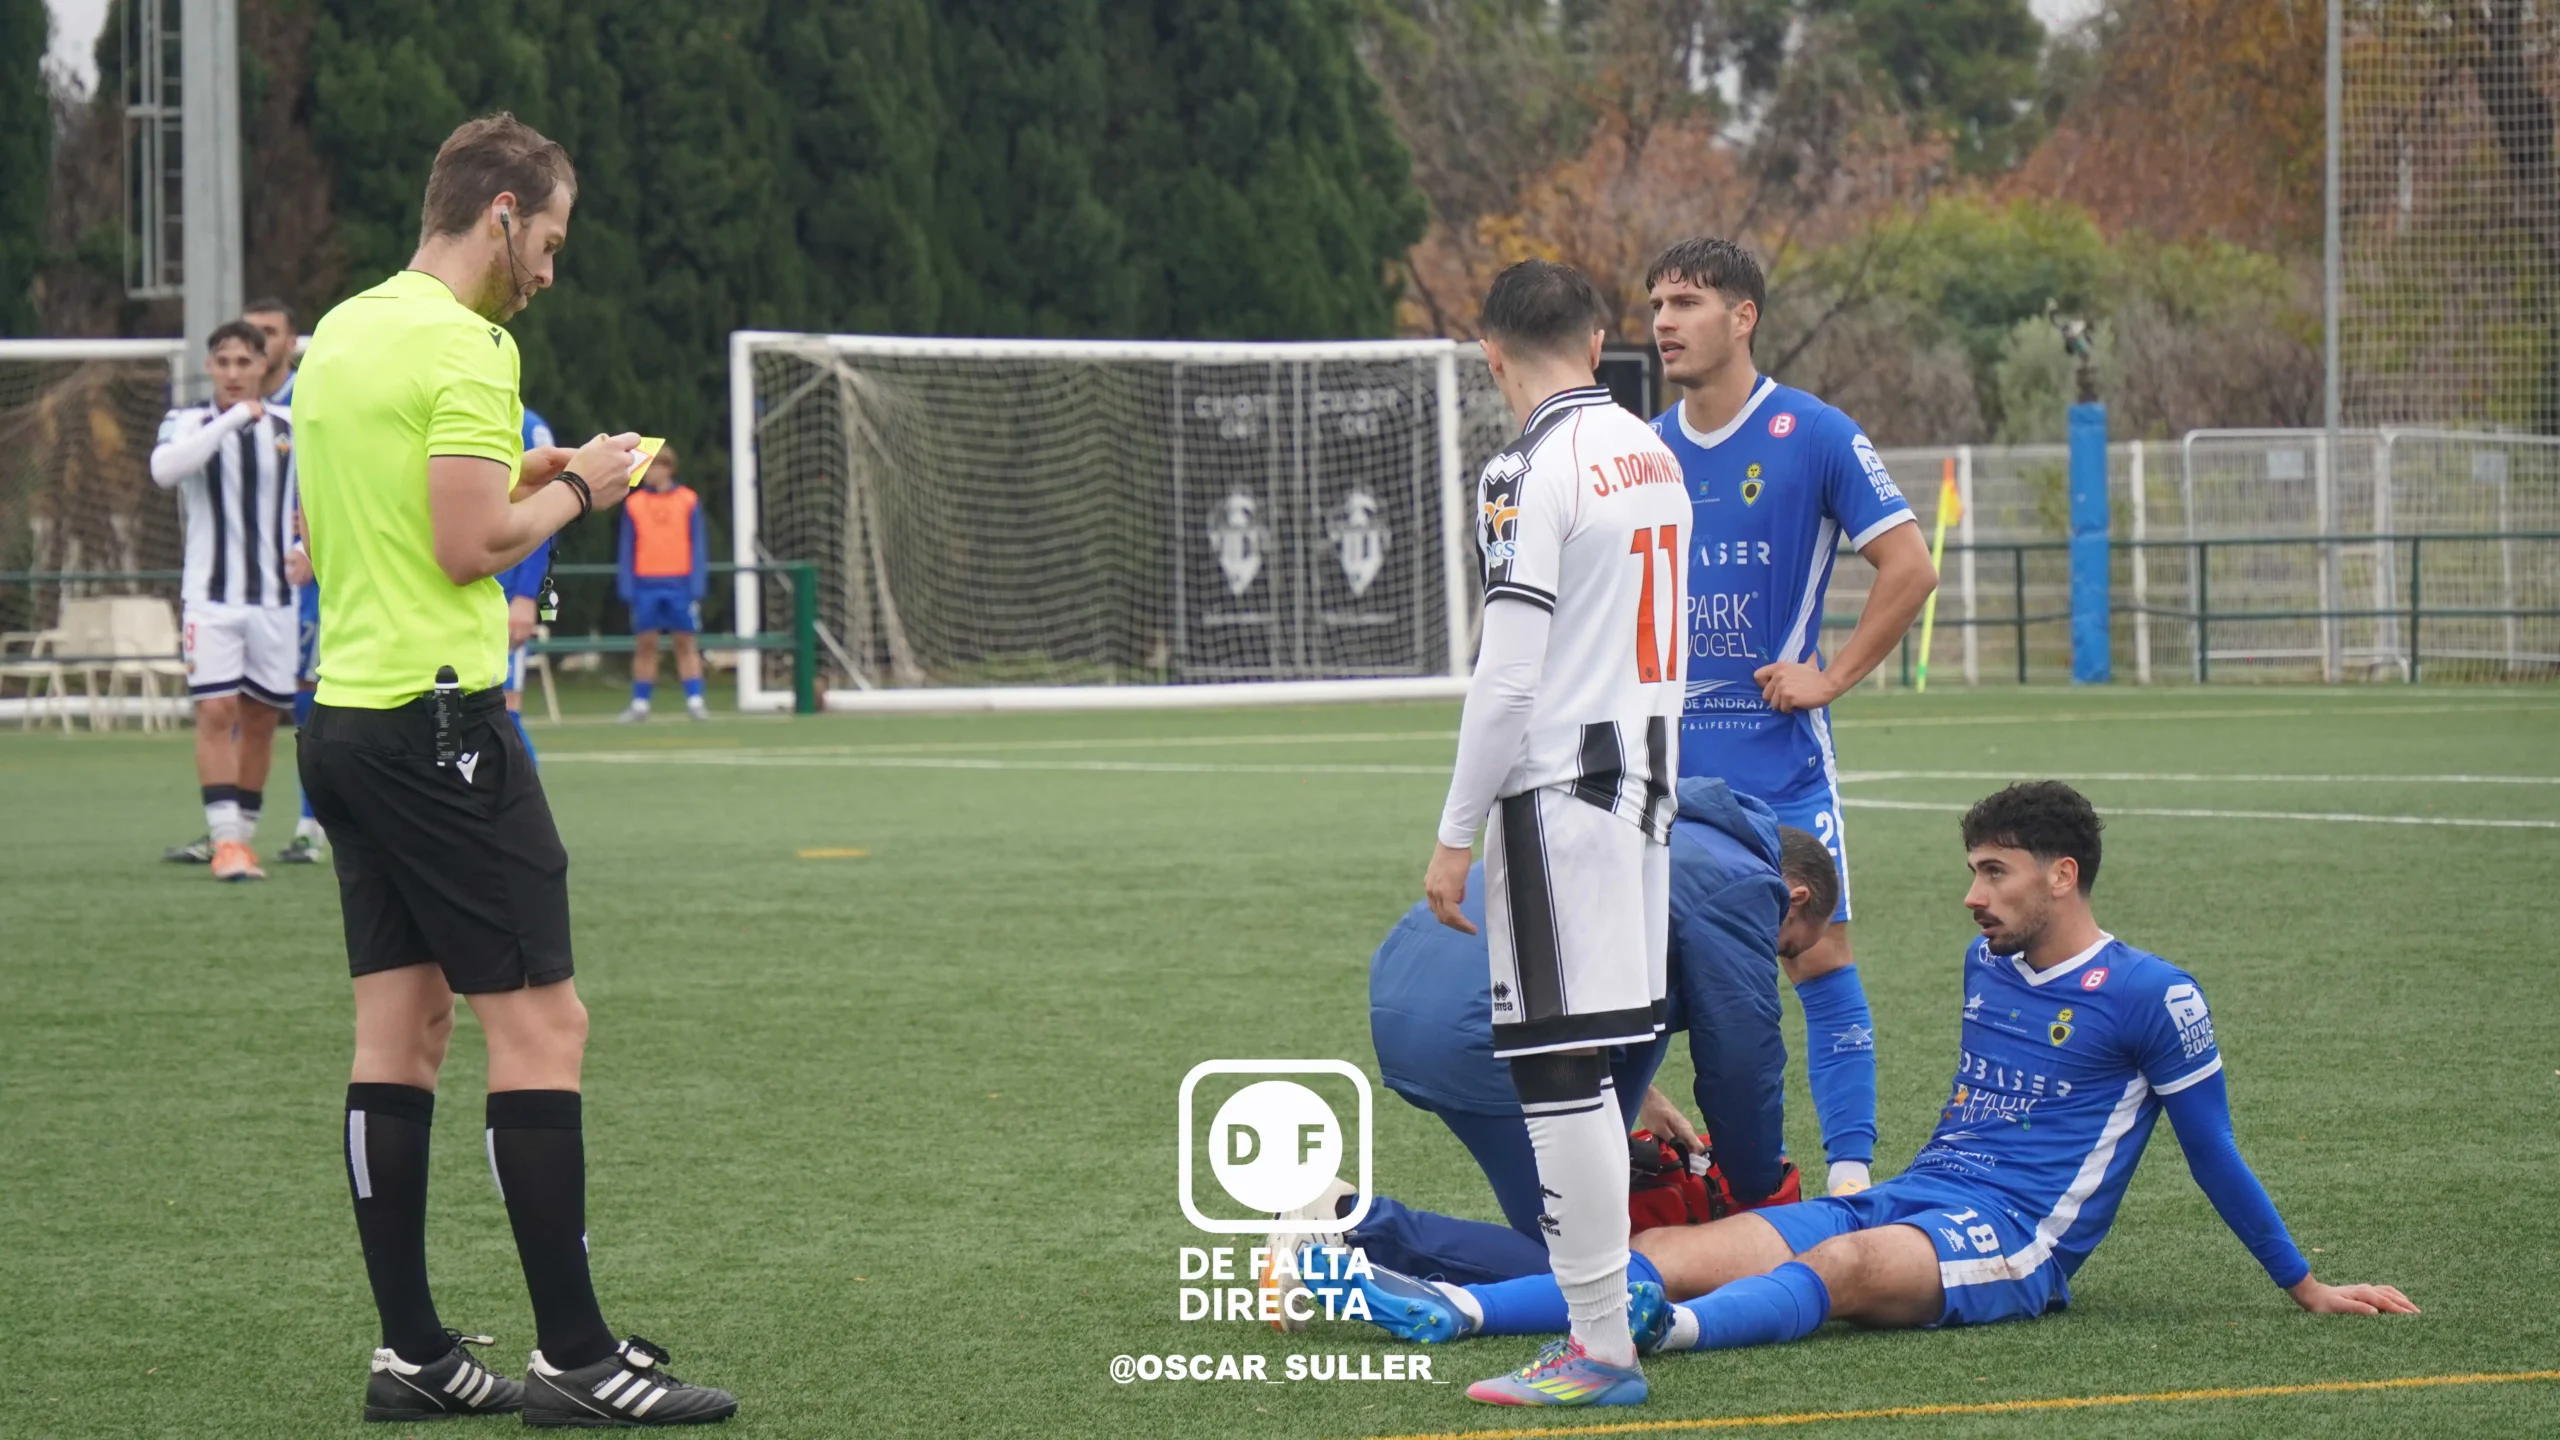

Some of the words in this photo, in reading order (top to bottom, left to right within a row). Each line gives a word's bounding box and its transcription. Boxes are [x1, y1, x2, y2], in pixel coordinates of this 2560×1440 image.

[1590, 464, 1618, 497] J.
[1868, 470, 1894, 488] NOV
[1875, 484, 1903, 501] 200
[1630, 523, 1677, 684] 11
[1698, 721, 1762, 730] LIFESTYLE
[1942, 1206, 2000, 1253] 18
